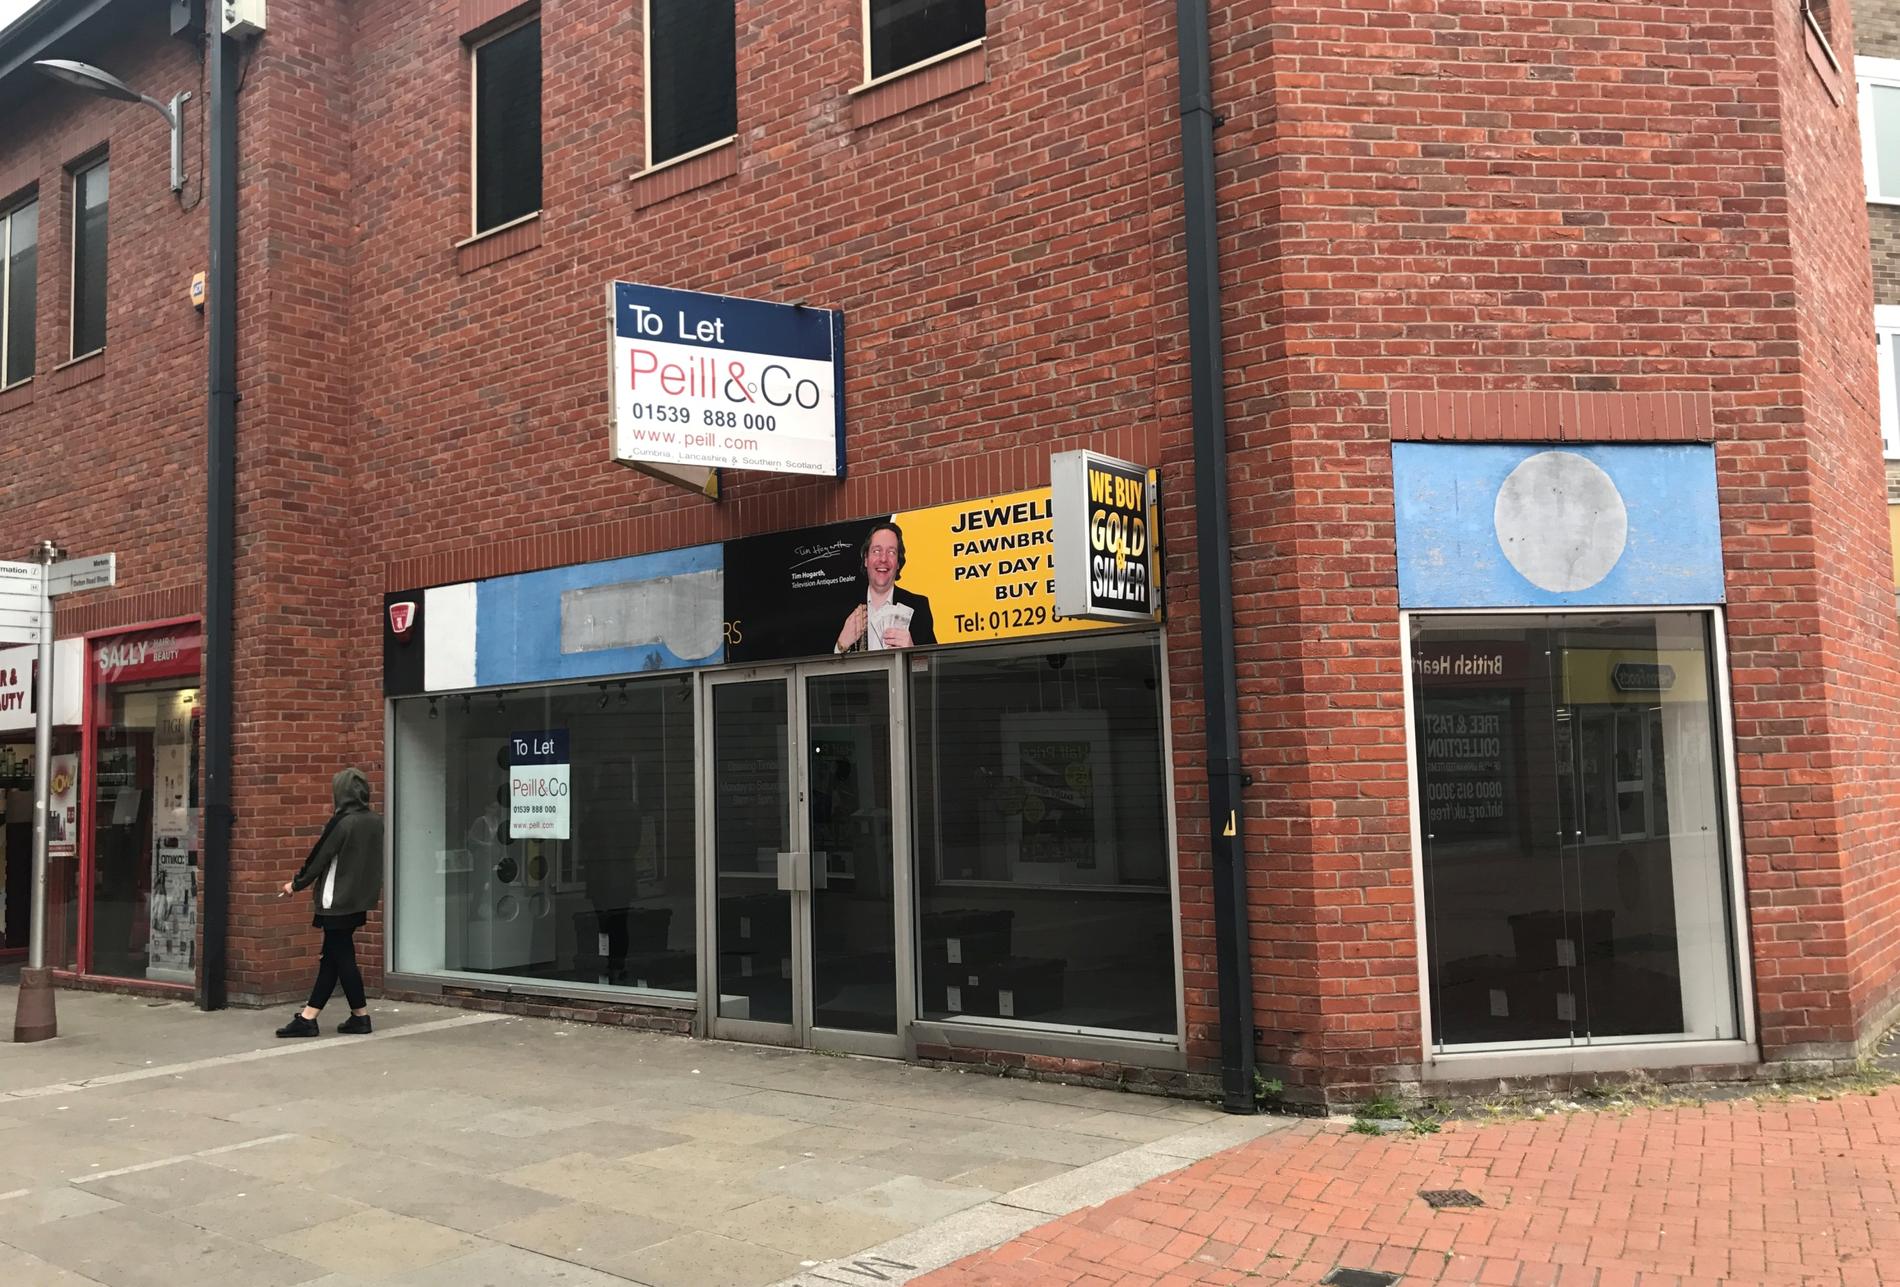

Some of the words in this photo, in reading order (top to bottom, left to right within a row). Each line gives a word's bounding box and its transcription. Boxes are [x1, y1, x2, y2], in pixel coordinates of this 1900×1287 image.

[629, 304, 663, 336] To
[679, 311, 724, 343] Let
[632, 403, 690, 424] 01539
[703, 410, 737, 428] 888
[743, 413, 776, 431] 000
[633, 429, 758, 451] www.peill.com
[678, 452, 728, 463] Lancashire
[731, 456, 738, 464] &
[742, 457, 782, 468] Southern
[785, 460, 823, 470] Scotland
[1089, 469, 1113, 506] WE
[1115, 475, 1143, 512] BUY
[1091, 509, 1145, 557] GOLD
[954, 563, 992, 580] PAY
[998, 556, 1040, 575] DAY
[1093, 555, 1145, 602] SILVER
[792, 580, 815, 588] Television
[816, 577, 838, 586] Antiques
[839, 575, 856, 583] Dealer
[996, 581, 1037, 600] BUY
[954, 612, 985, 633] Tel:
[989, 606, 1046, 630] 01229
[99, 641, 148, 669] SALLY
[153, 650, 179, 662] BEAUTY
[10, 668, 17, 686] &
[0, 691, 24, 711] UTY
[513, 739, 528, 756] To
[534, 738, 554, 755] Let
[513, 806, 530, 814] 01539
